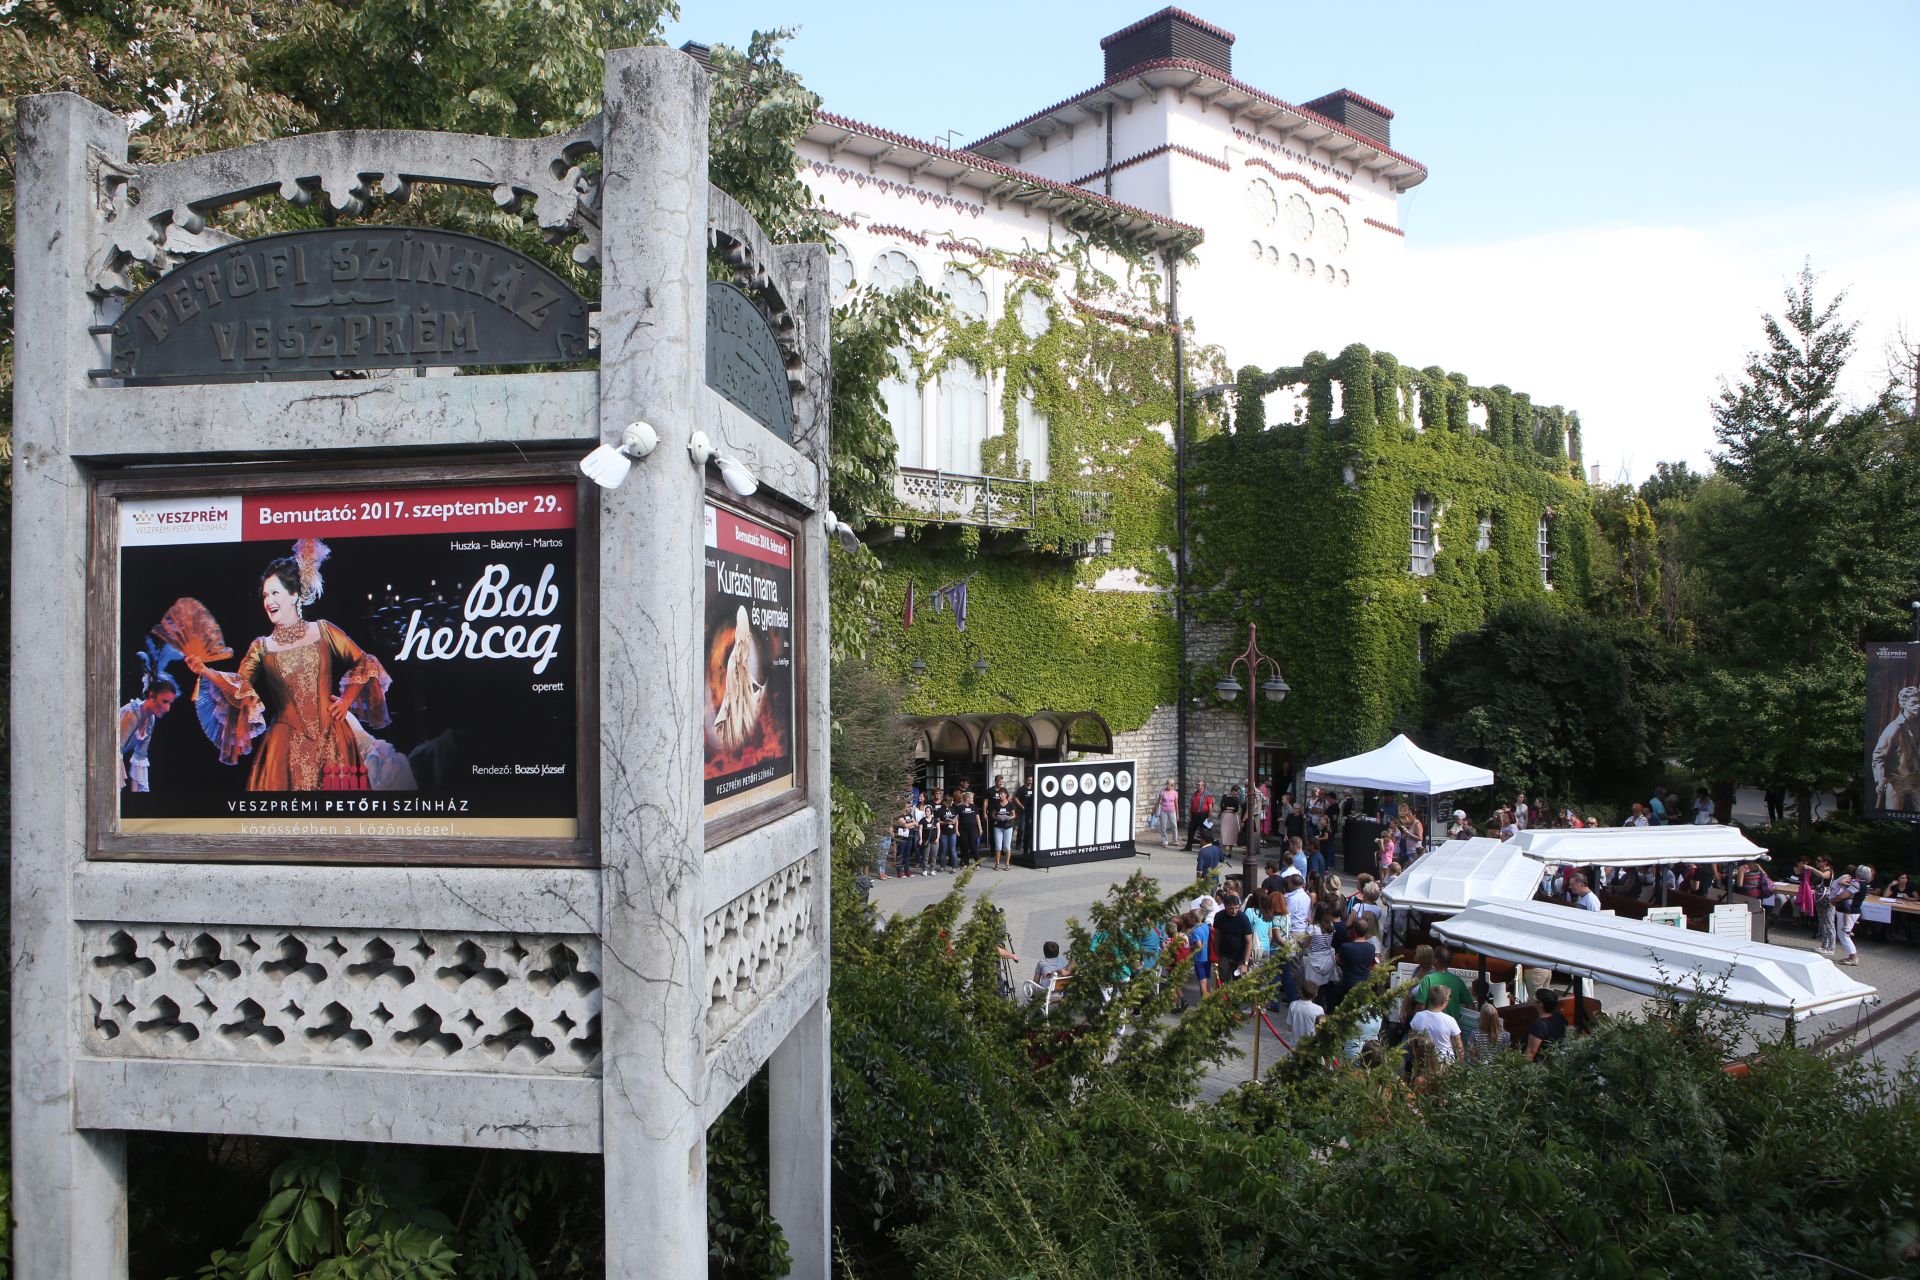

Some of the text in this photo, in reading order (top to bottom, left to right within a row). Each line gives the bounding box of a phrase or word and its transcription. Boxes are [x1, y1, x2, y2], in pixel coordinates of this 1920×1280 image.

[331, 229, 563, 331] SZÍNHÁZ
[211, 304, 480, 362] VESZPRÉM
[157, 506, 228, 524] VESZPRÉM
[259, 494, 562, 525] Bemutató: 2017. szeptember 29.
[450, 540, 481, 551] Huszka
[490, 538, 523, 551] Bakonyi
[533, 537, 563, 549] Martos
[464, 563, 559, 621] Bob
[717, 559, 778, 603] Kurázsi mama
[751, 601, 789, 632] és gyermekei
[394, 609, 562, 675] herceg
[532, 682, 564, 694] operett
[472, 763, 566, 777] Rendező: Bozsó József
[716, 777, 742, 796] VESZPRÉMI
[227, 797, 469, 812] VESZPRÉMI PETŐFI SZÍNHÁZ
[344, 825, 352, 835] a
